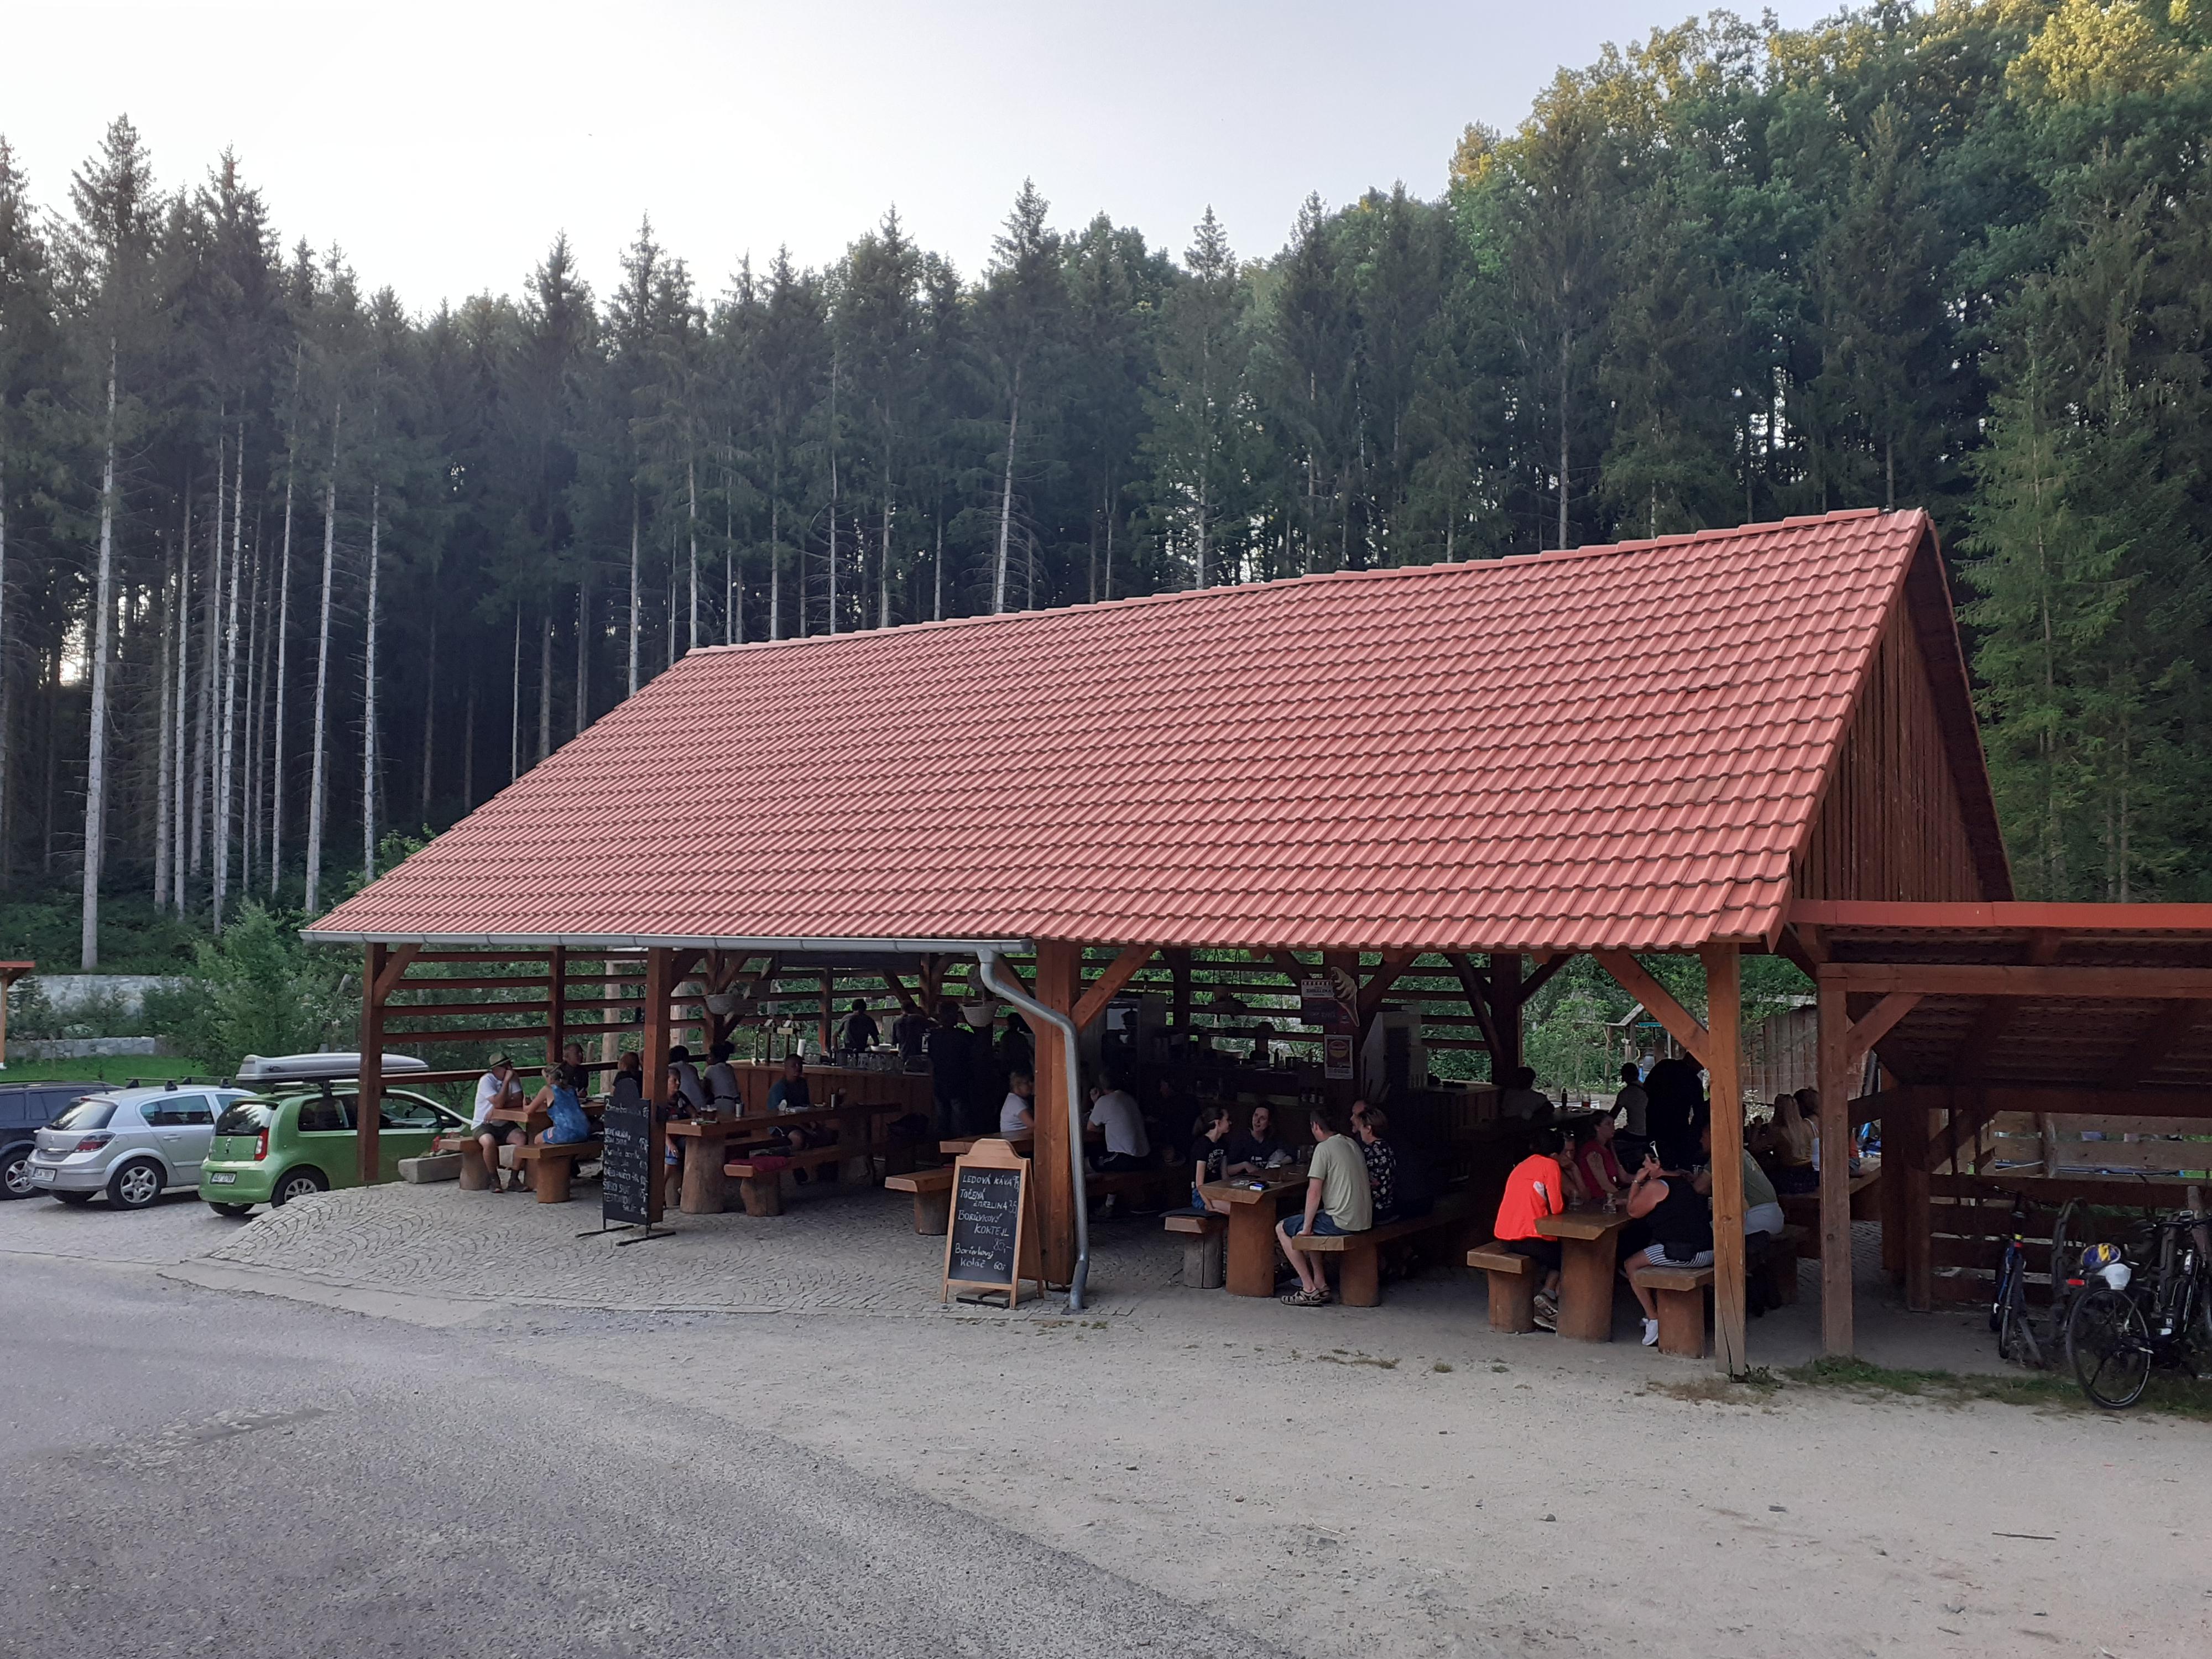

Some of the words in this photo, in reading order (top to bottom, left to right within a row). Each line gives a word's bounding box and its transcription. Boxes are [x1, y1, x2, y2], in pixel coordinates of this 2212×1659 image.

[963, 1173, 991, 1185] LEDOVÁ
[993, 1175, 1012, 1186] KÁVA
[960, 1187, 986, 1200] TOČENÁ
[974, 1223, 1009, 1237] KOKTEJL
